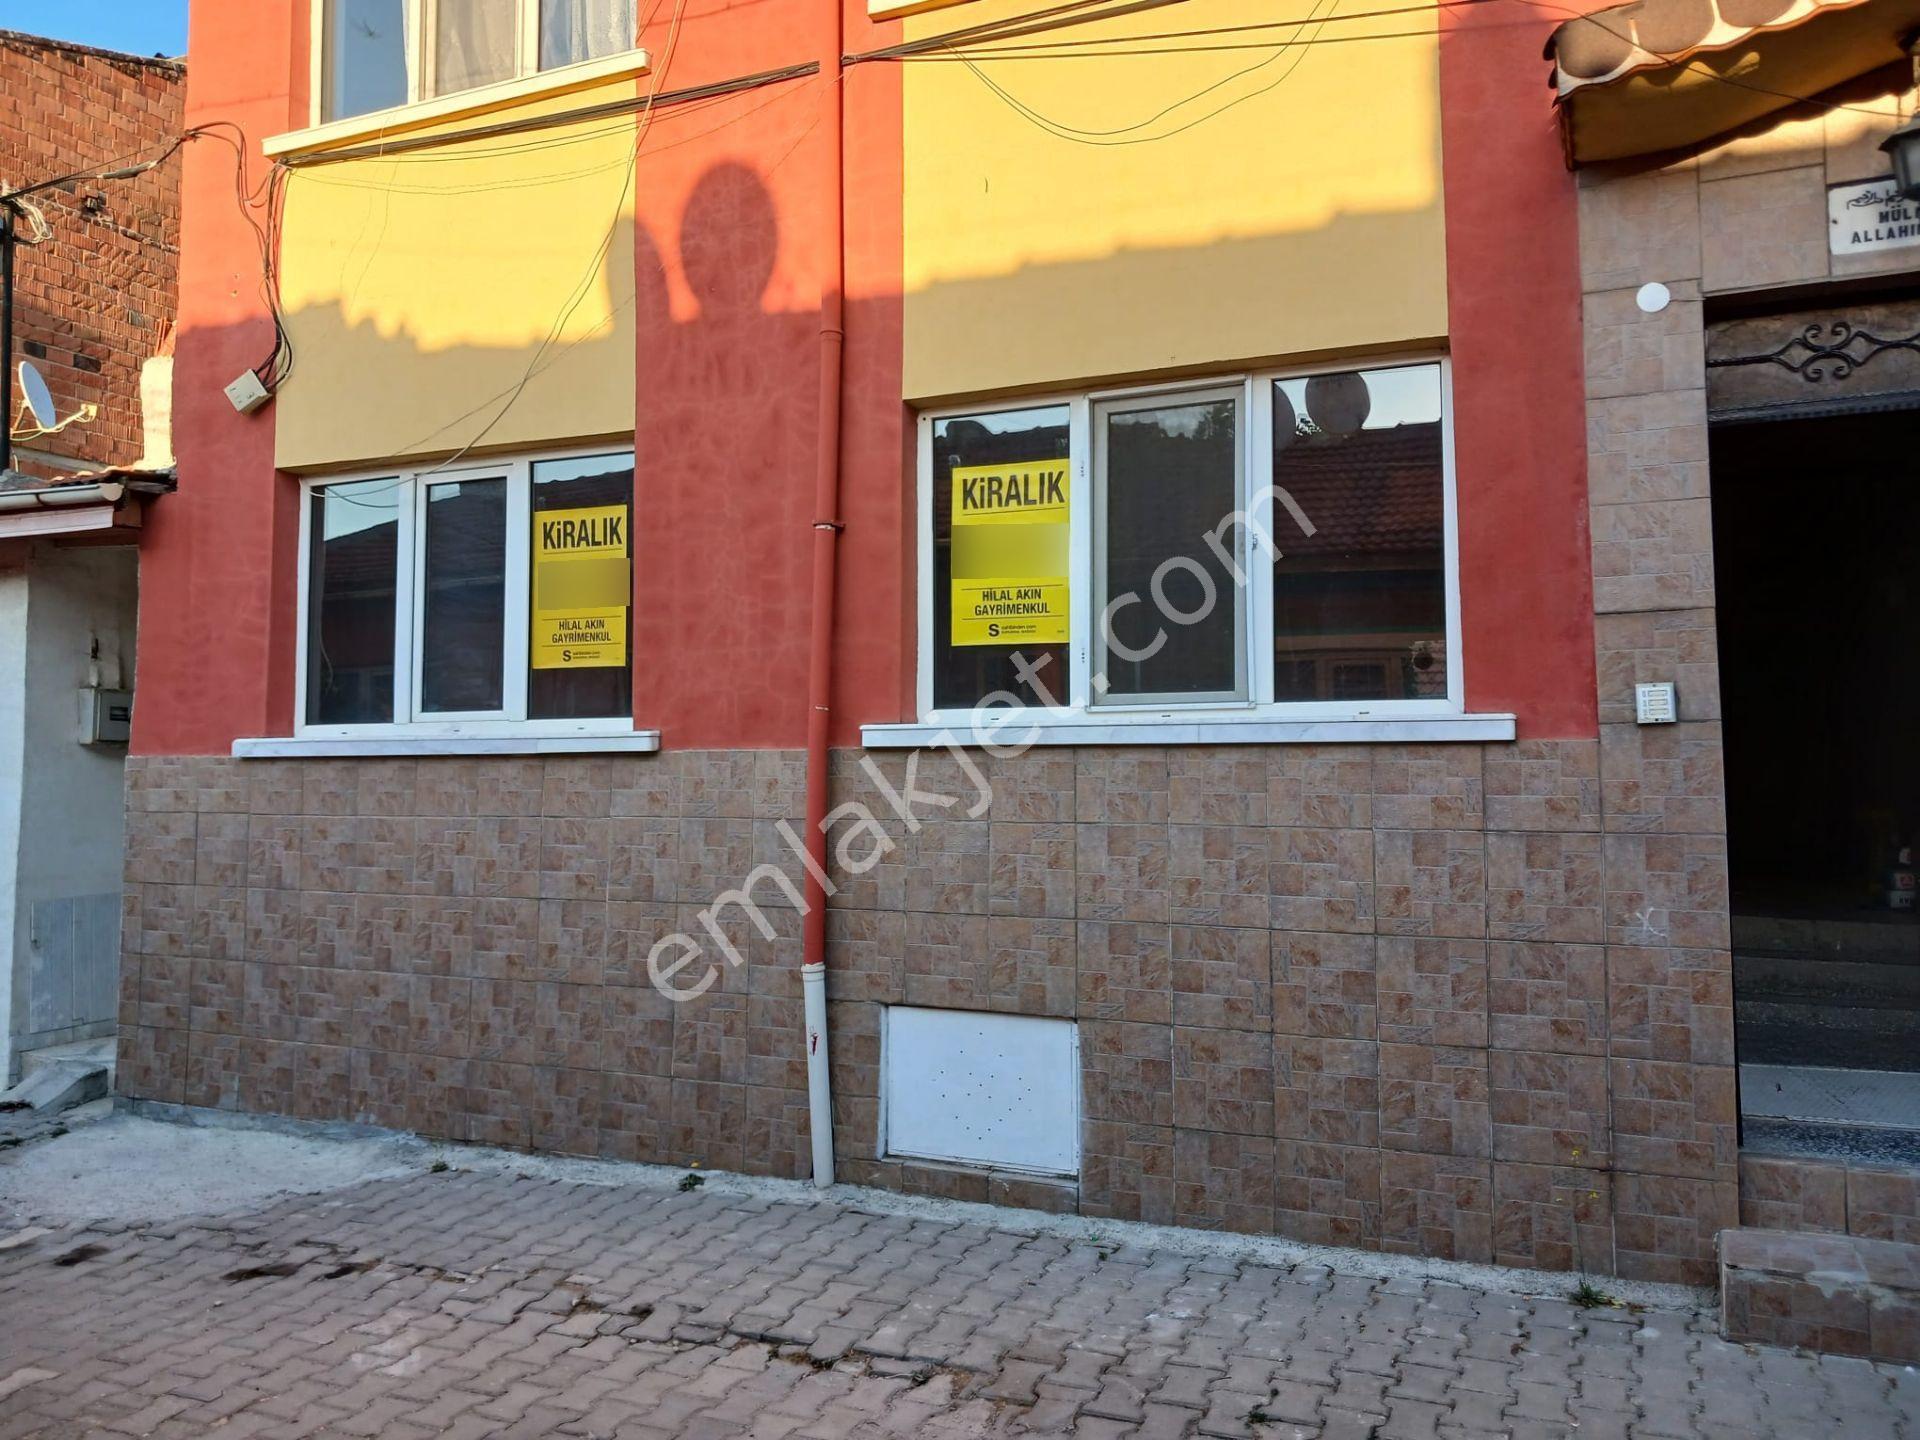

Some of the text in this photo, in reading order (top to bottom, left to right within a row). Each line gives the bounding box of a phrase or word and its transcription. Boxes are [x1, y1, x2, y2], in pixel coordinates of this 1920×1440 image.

[1851, 223, 1920, 244] ALLAHI
[982, 588, 1041, 601] HİLAL AKIN
[974, 602, 1050, 616] GAYRİMENKUL
[559, 619, 605, 631] HİLAL AKIN
[988, 623, 1000, 637] S
[551, 631, 611, 643] GAYRİMENKUL
[562, 649, 572, 662] S
